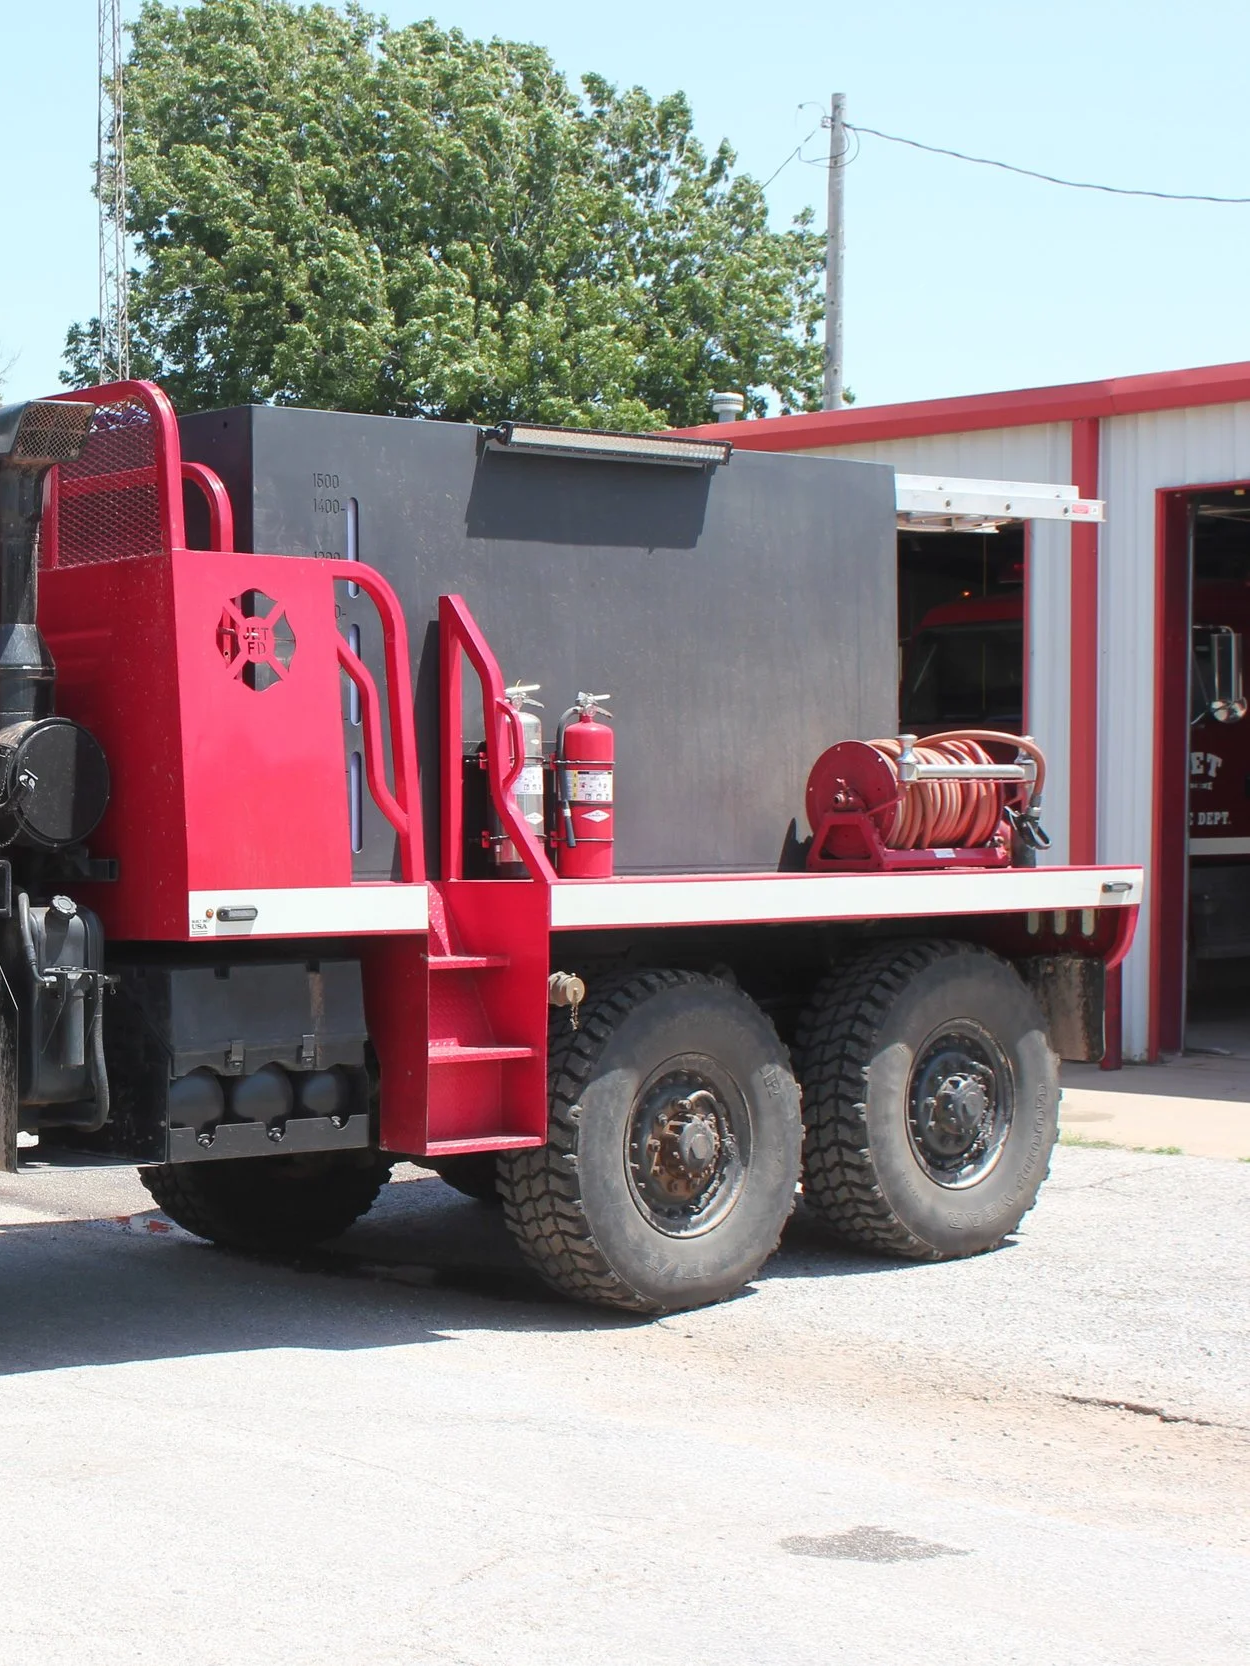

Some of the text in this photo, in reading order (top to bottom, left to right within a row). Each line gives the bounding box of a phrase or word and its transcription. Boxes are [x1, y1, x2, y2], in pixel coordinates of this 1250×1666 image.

[313, 472, 340, 489] 1500
[242, 626, 269, 641] JET
[247, 641, 266, 655] FD
[1190, 751, 1223, 778] ET
[1197, 811, 1232, 826] DEPT.
